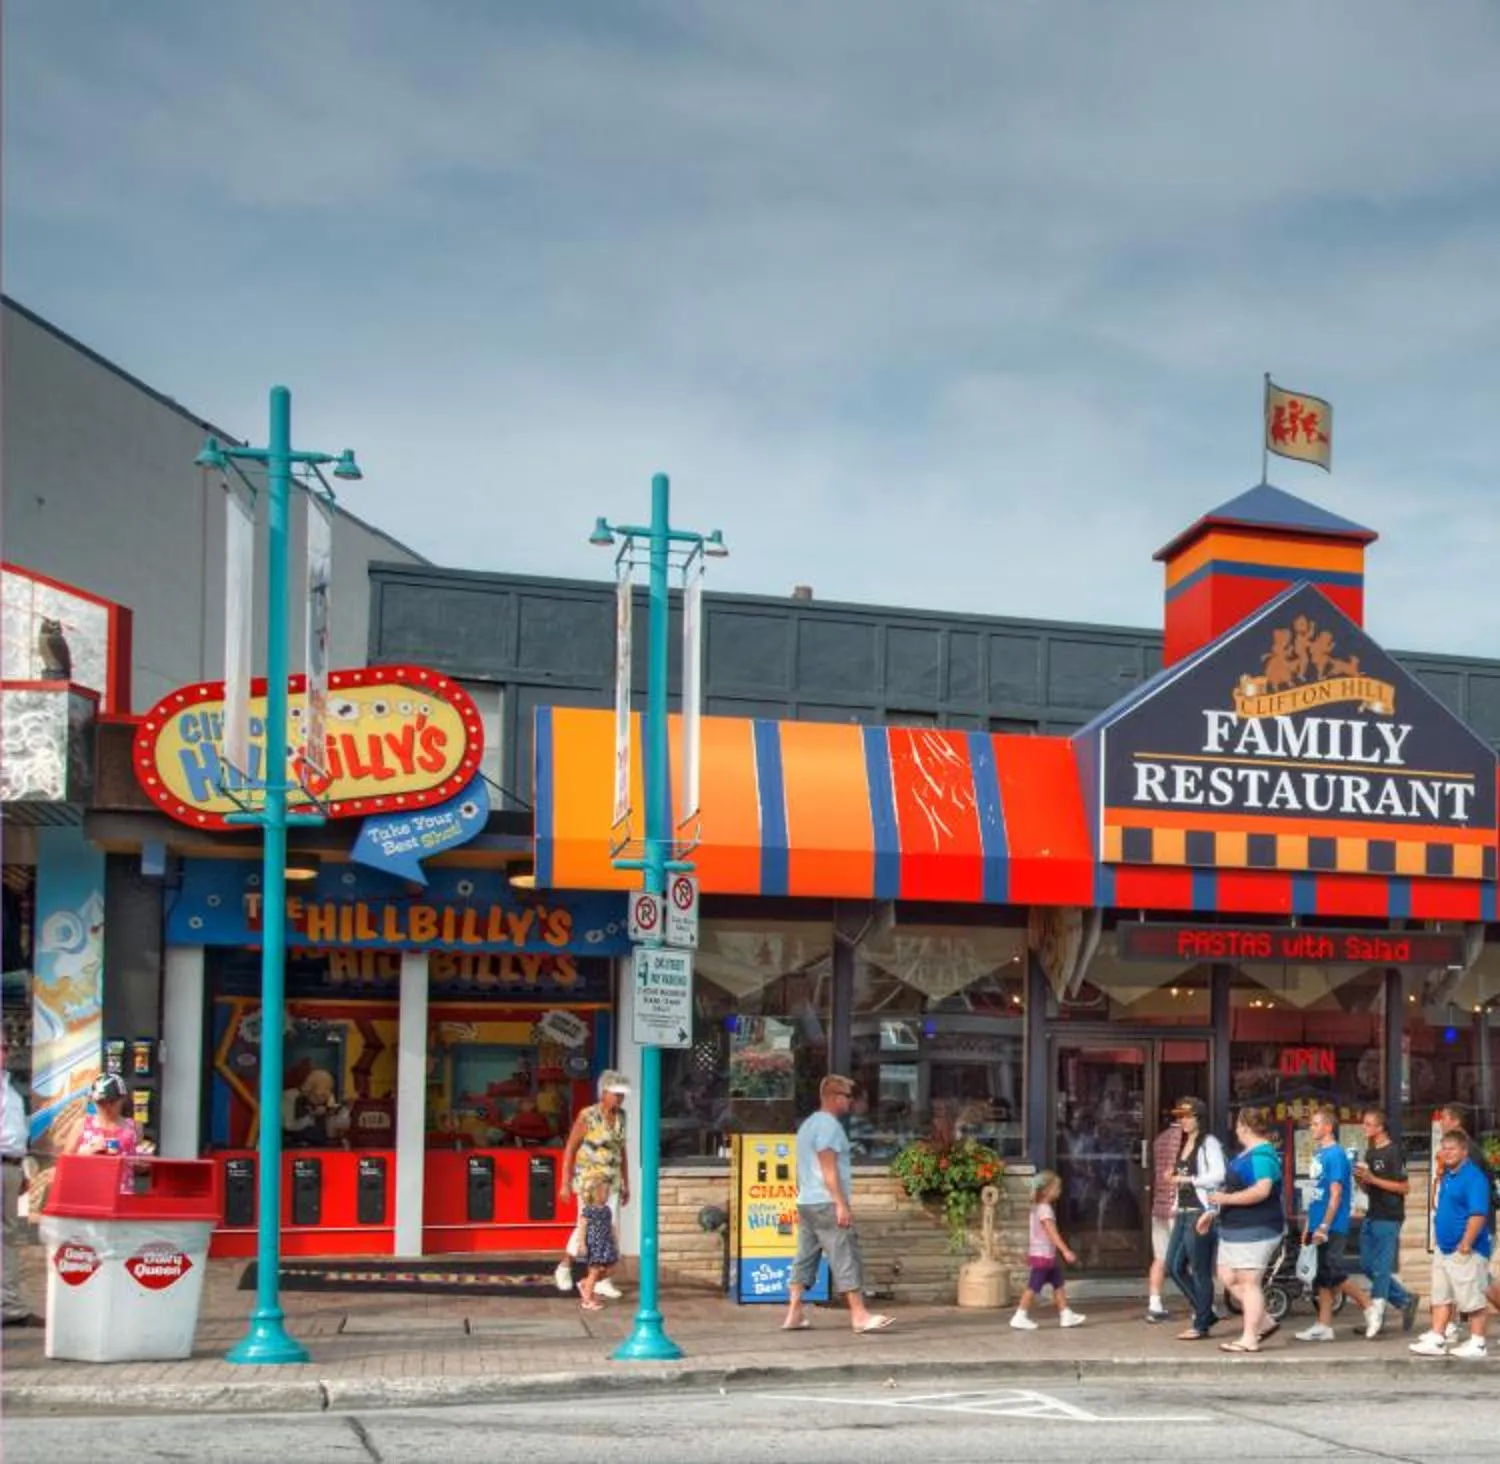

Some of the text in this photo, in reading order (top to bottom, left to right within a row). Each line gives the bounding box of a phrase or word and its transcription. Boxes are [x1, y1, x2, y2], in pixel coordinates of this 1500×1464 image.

[1241, 680, 1389, 716] CLIFTON HILL
[178, 711, 268, 743] Clio
[1202, 709, 1413, 766] FAMILY
[1133, 762, 1476, 821] RESTAURANT
[367, 811, 454, 844] Take Your
[381, 836, 420, 857] Best
[306, 901, 574, 947] HILLBILLY'S
[1178, 929, 1272, 957] PASTAS
[1345, 935, 1411, 962] Salad
[328, 951, 580, 987] HILBILLY'S
[1280, 1047, 1336, 1077] OPEN
[748, 1184, 799, 1199] CHAN
[134, 1263, 182, 1278] Queen
